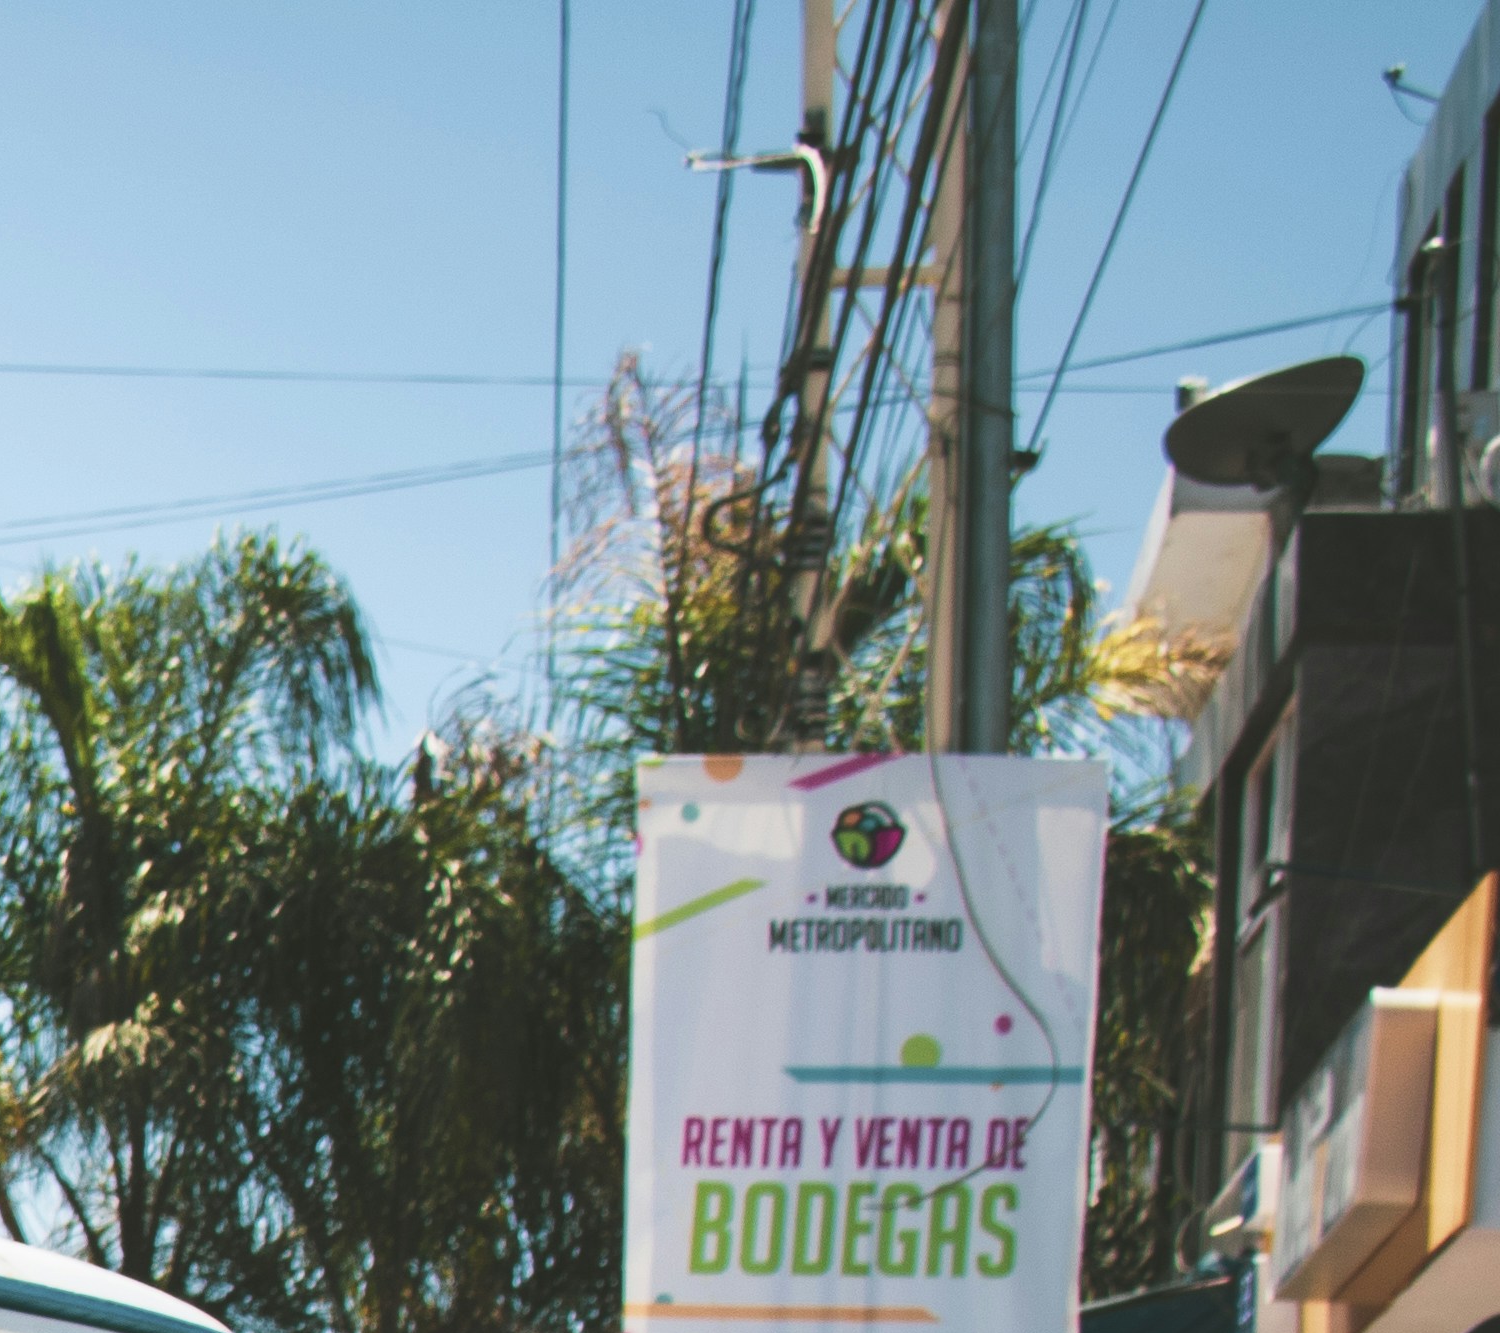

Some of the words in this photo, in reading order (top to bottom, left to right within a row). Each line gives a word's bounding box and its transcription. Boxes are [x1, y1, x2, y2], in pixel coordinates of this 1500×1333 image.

[826, 886, 909, 910] MERCADO
[769, 918, 963, 952] METROPOLITANO
[681, 1117, 803, 1168] RENTA
[819, 1117, 842, 1169] Y
[854, 1117, 971, 1169] VENTA
[983, 1118, 1029, 1171] DE
[688, 1180, 1020, 1278] BODEGAS
